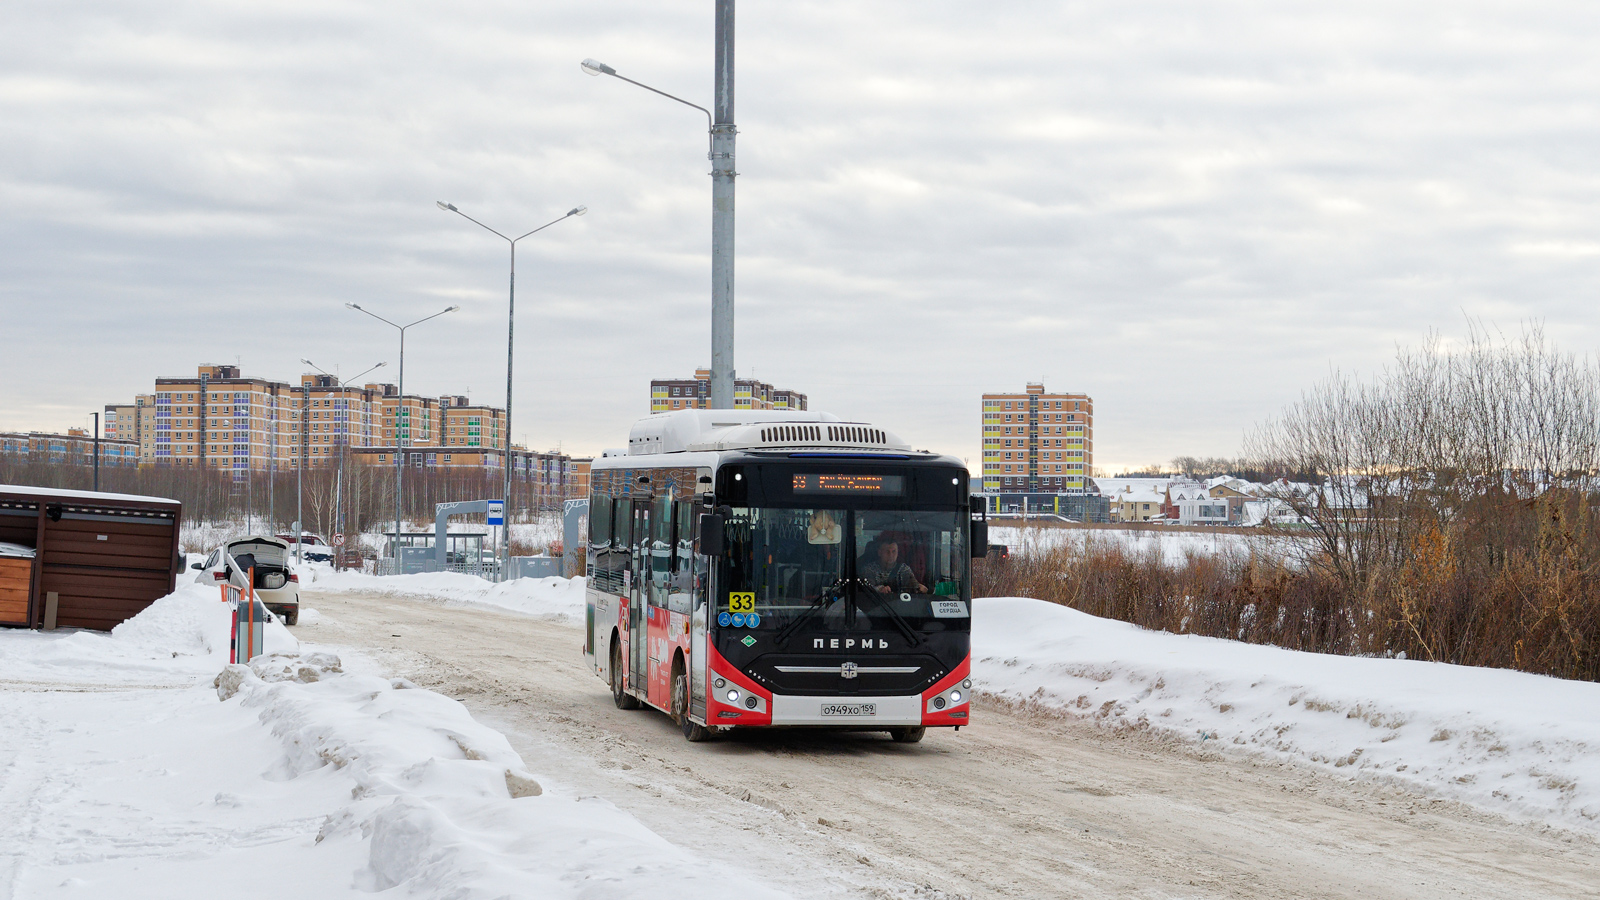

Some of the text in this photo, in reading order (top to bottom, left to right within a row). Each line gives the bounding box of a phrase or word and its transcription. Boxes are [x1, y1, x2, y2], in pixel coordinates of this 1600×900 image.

[731, 594, 752, 609] 33
[813, 638, 889, 649] ПЕРМЬ
[861, 704, 874, 712] 159
